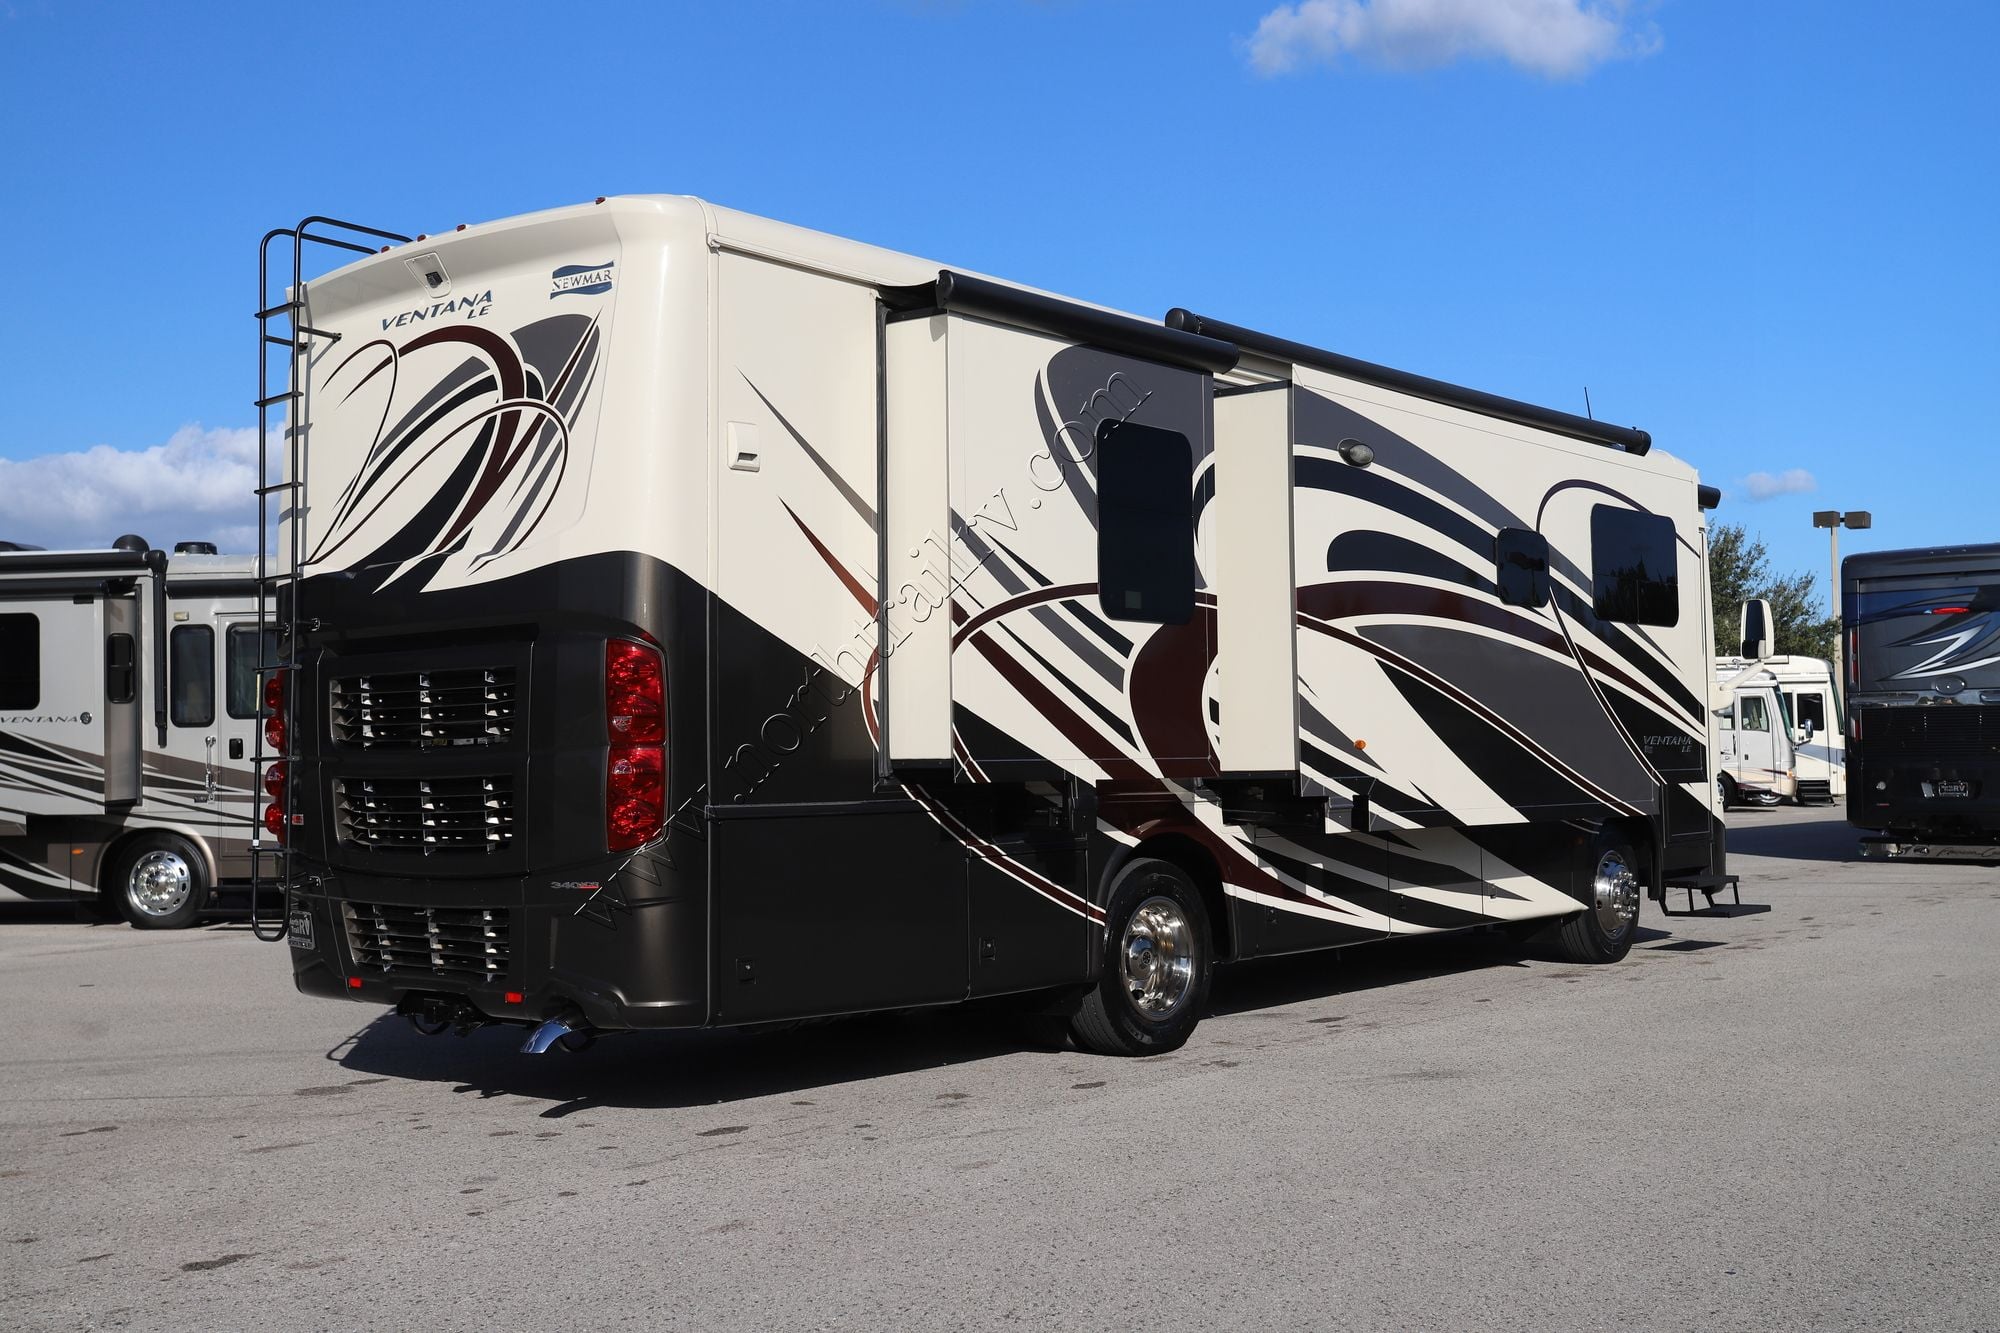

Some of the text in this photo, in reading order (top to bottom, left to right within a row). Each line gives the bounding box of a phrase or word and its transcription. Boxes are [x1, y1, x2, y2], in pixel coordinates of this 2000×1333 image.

[552, 269, 613, 292] NEWMAR
[382, 289, 492, 331] VENTANA
[467, 304, 493, 319] LE
[1643, 736, 1692, 745] VENTANA
[1681, 745, 1693, 753] LE
[299, 918, 310, 936] RV
